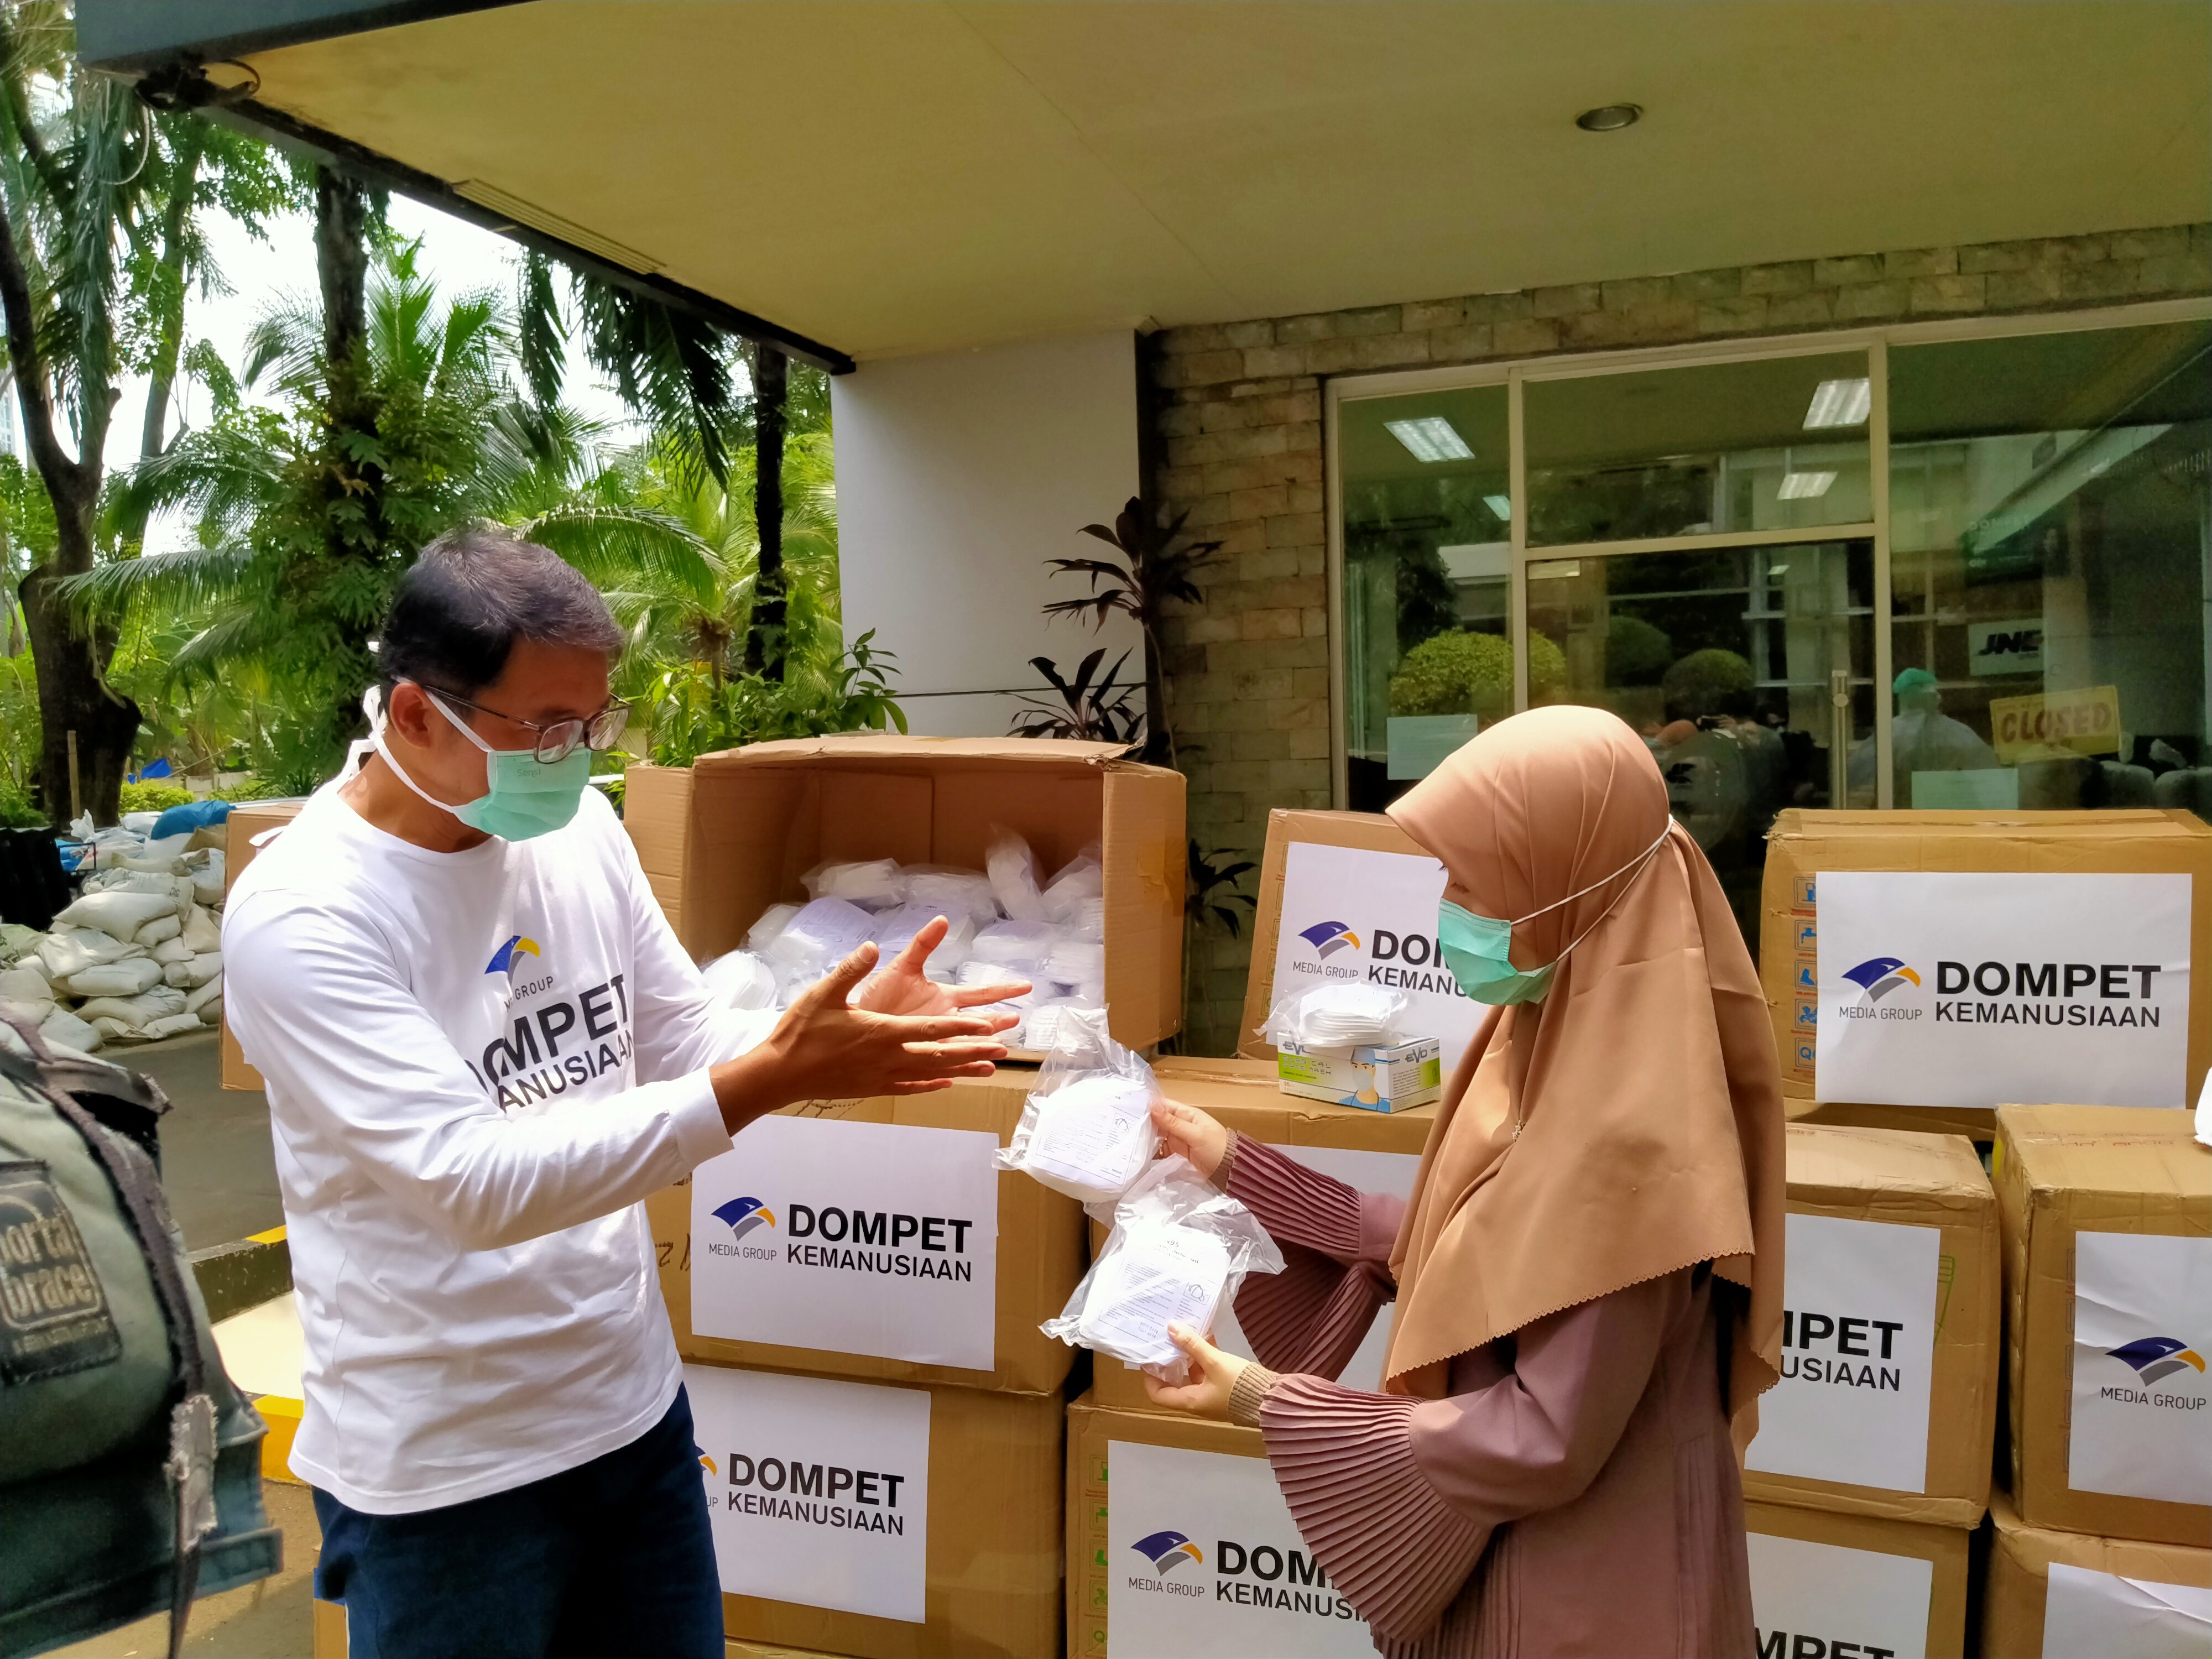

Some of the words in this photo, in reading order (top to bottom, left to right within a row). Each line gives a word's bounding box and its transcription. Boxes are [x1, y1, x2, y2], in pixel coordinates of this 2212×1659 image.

[2000, 702, 2112, 743] CLOSED
[515, 976, 554, 1000] GROUP
[1292, 961, 1323, 975] MEDIA
[1326, 966, 1359, 978] GROUP
[1936, 961, 2161, 999] DOMPET
[1839, 1006, 1877, 1019] MEDIA
[1880, 1008, 1923, 1020] GROUP
[1936, 1001, 2160, 1027] KEMANUSIAAN
[464, 974, 628, 1094] OMPET
[789, 1204, 973, 1253] DOMPET
[709, 1243, 740, 1258] MEDIA
[743, 1247, 777, 1261] GROUP
[787, 1244, 972, 1282] KEMANUSIAAN
[0, 1264, 94, 1318] brace
[2101, 1386, 2149, 1406] MEDIA
[2153, 1394, 2207, 1411] GROUP
[729, 1453, 905, 1508] DOMPET
[728, 1491, 904, 1536] KEMANUSIAAN
[1218, 1540, 1340, 1590] DOM
[1128, 1577, 1164, 1593] MEDIA
[1167, 1583, 1205, 1598] GROUP
[1217, 1580, 1367, 1622] KEMANUSI
